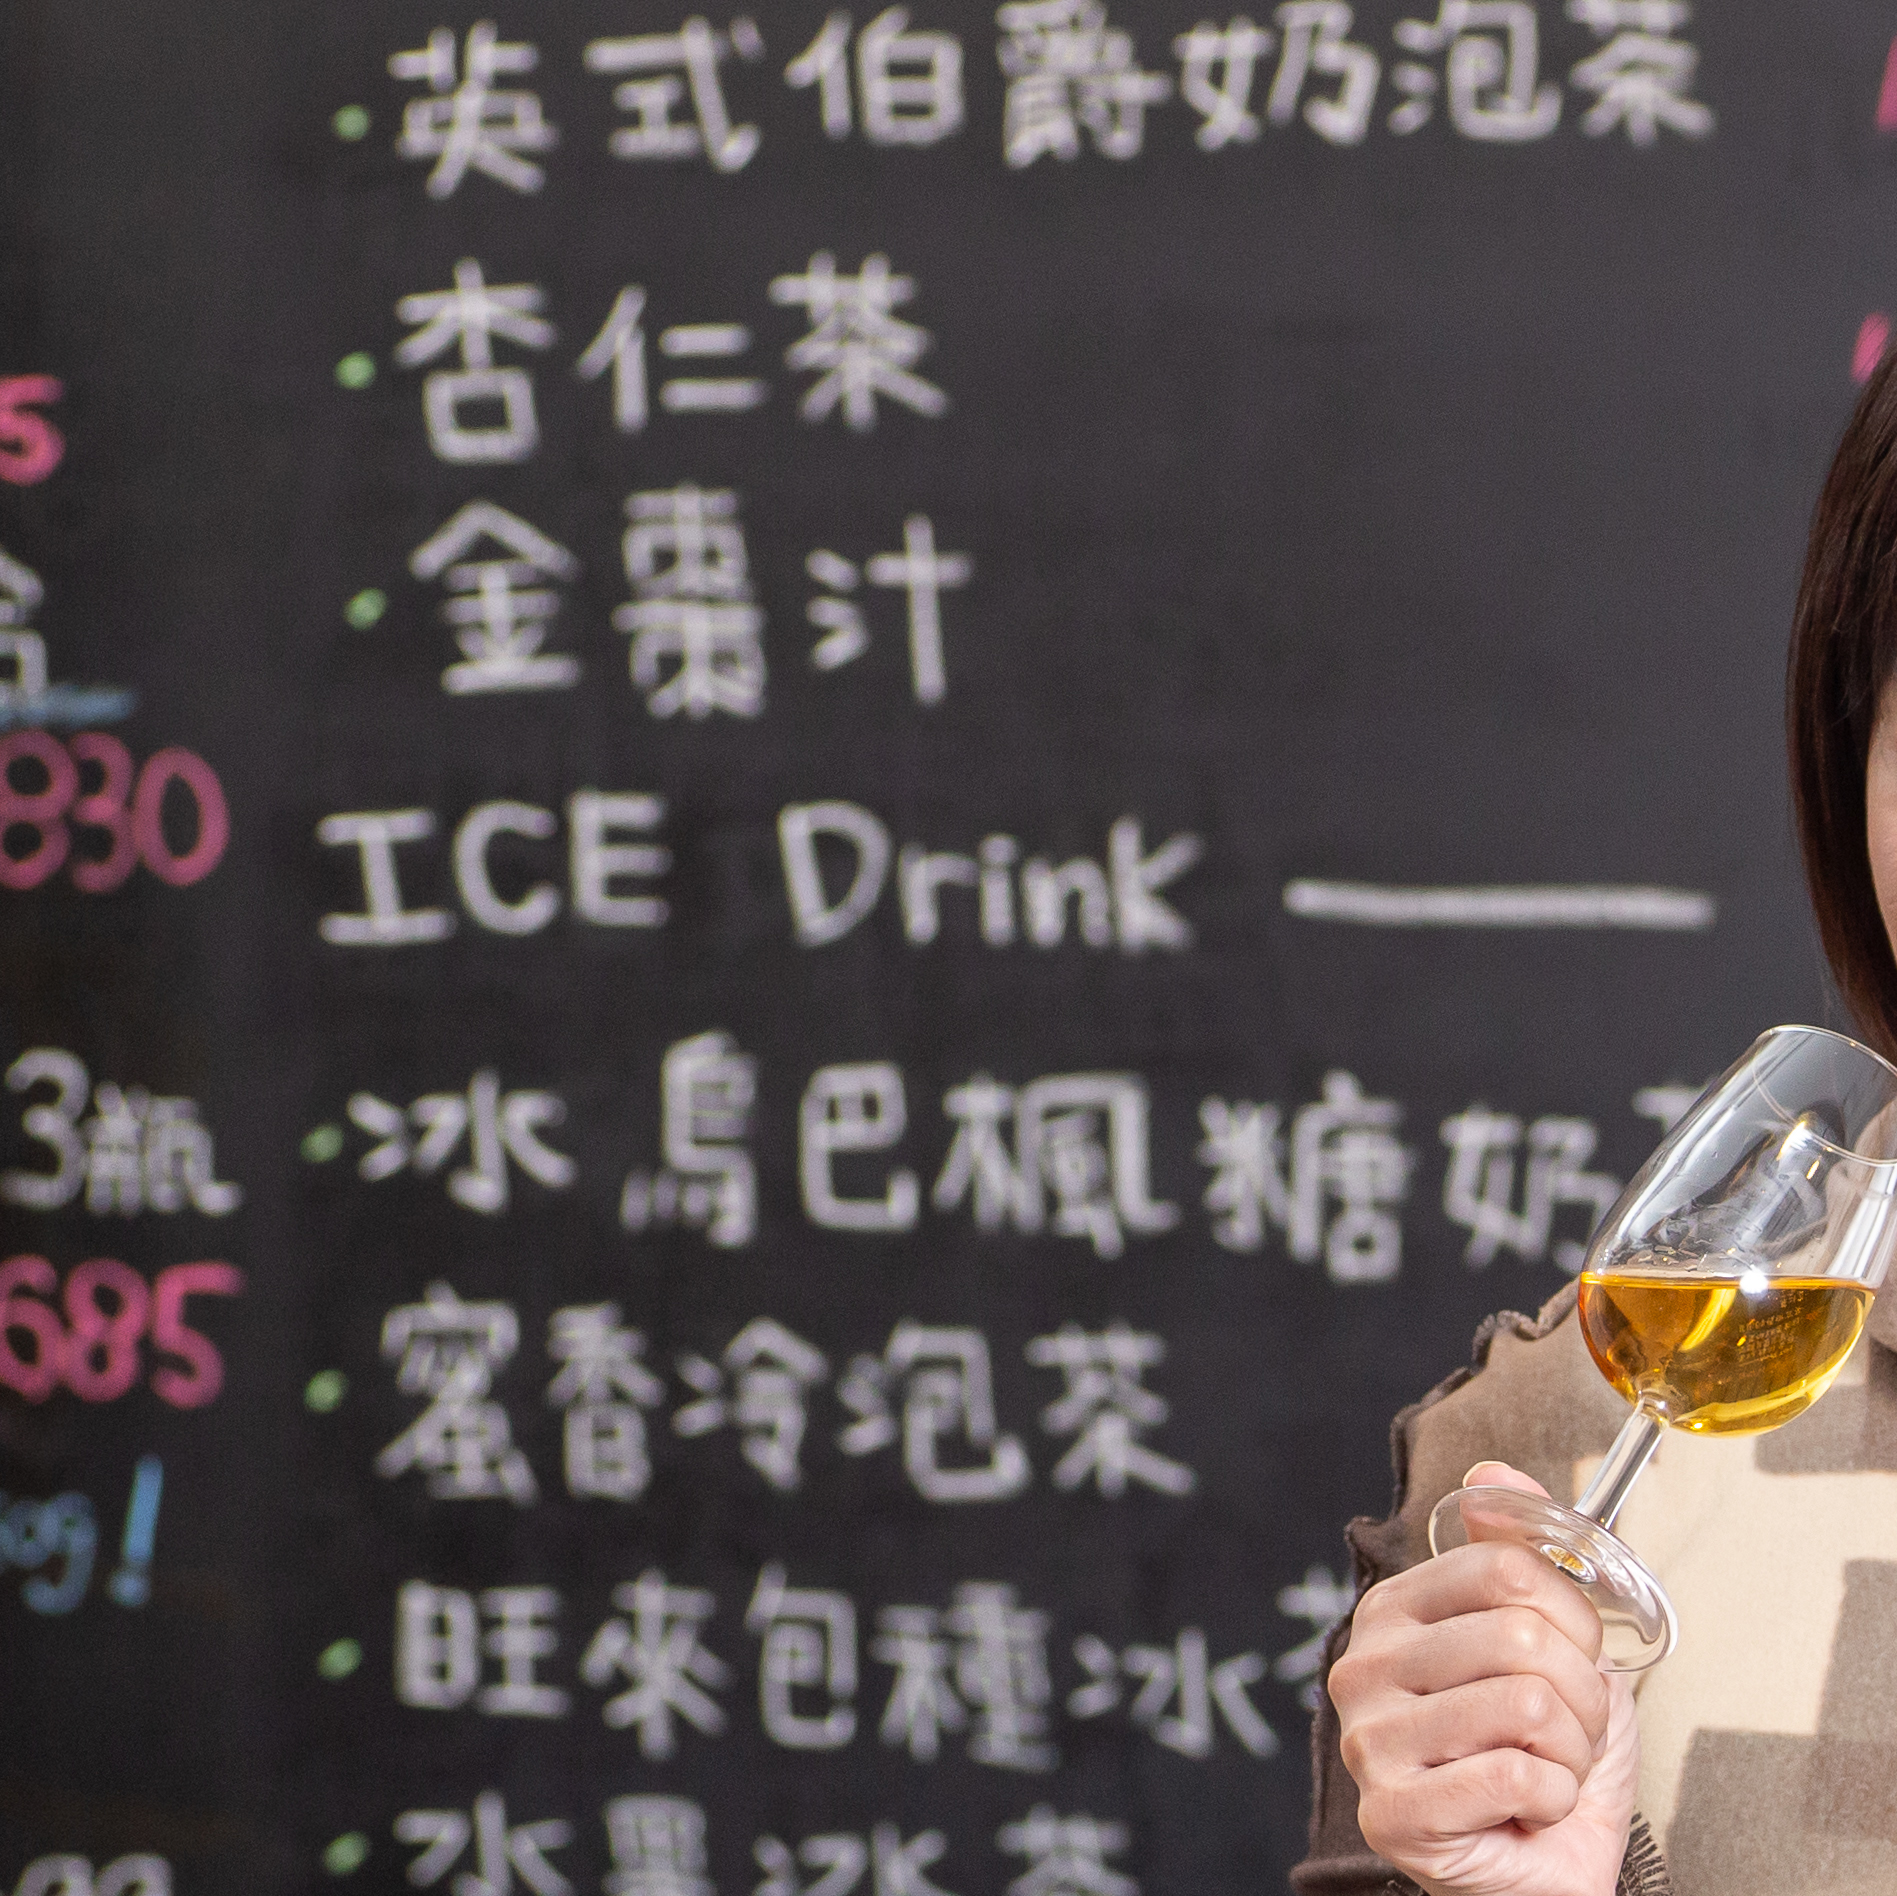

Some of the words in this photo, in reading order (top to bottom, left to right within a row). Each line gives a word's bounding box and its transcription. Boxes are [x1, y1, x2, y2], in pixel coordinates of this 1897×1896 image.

[396, 252, 947, 463] 杏仁茶
[319, 791, 673, 948] ICE
[776, 799, 1200, 954] Drink
[0, 1253, 246, 1410] 685
[376, 1284, 1197, 1502] 蜜香冷泡茶
